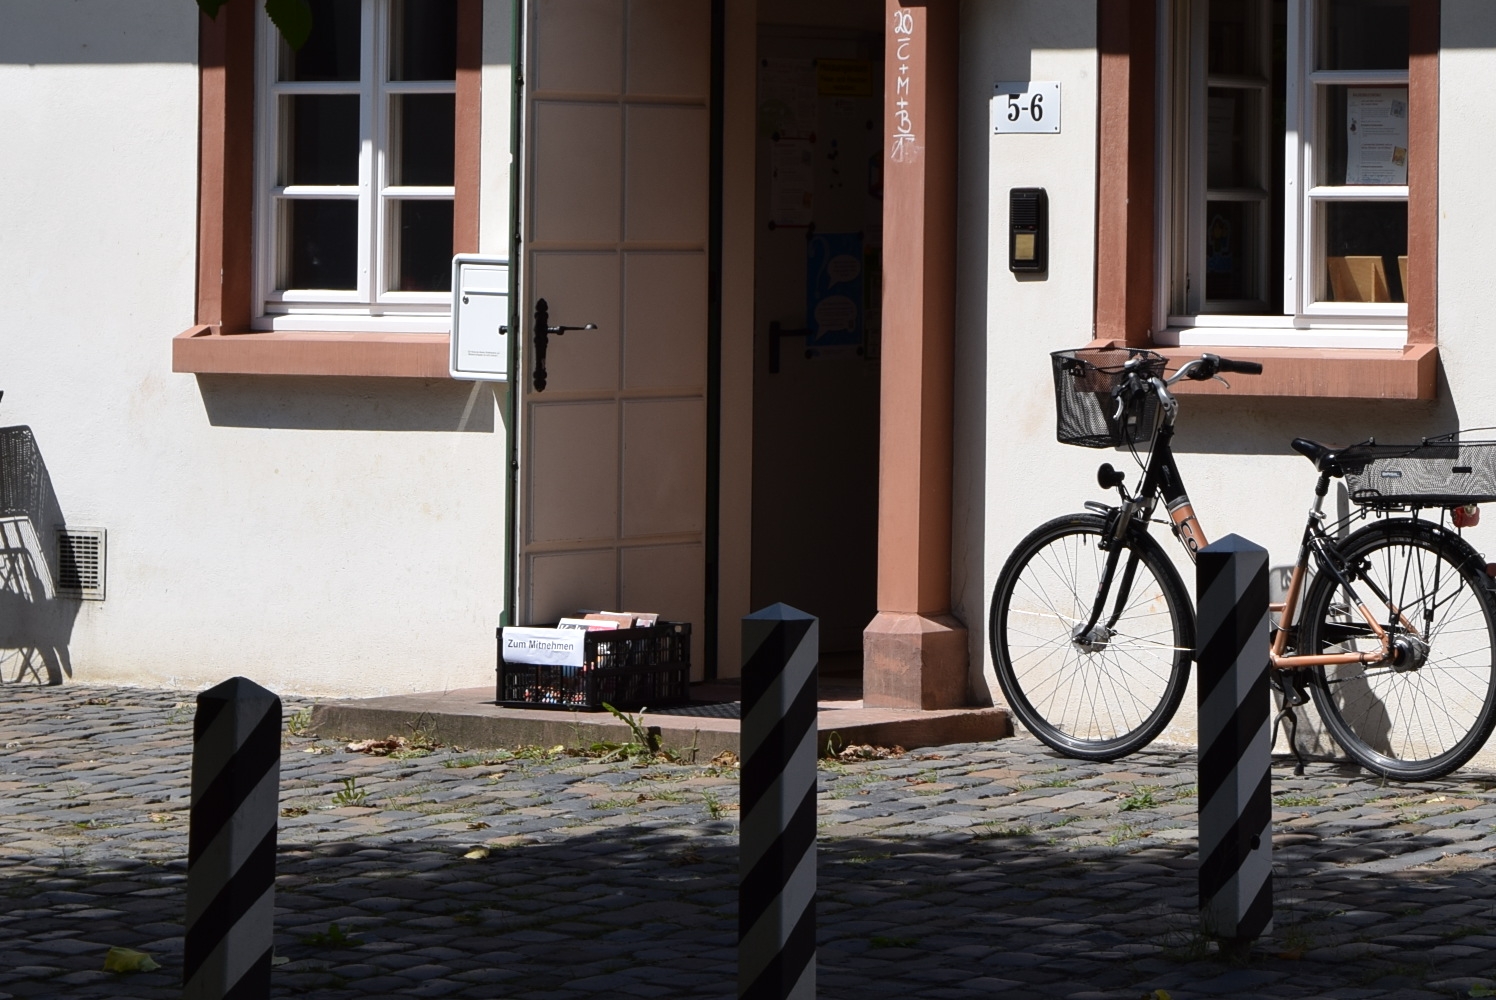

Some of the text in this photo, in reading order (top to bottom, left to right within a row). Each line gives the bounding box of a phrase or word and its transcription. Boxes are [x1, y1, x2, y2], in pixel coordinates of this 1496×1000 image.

[1007, 93, 1044, 122] 5-6
[507, 638, 574, 651] Zum Mitnehmen
